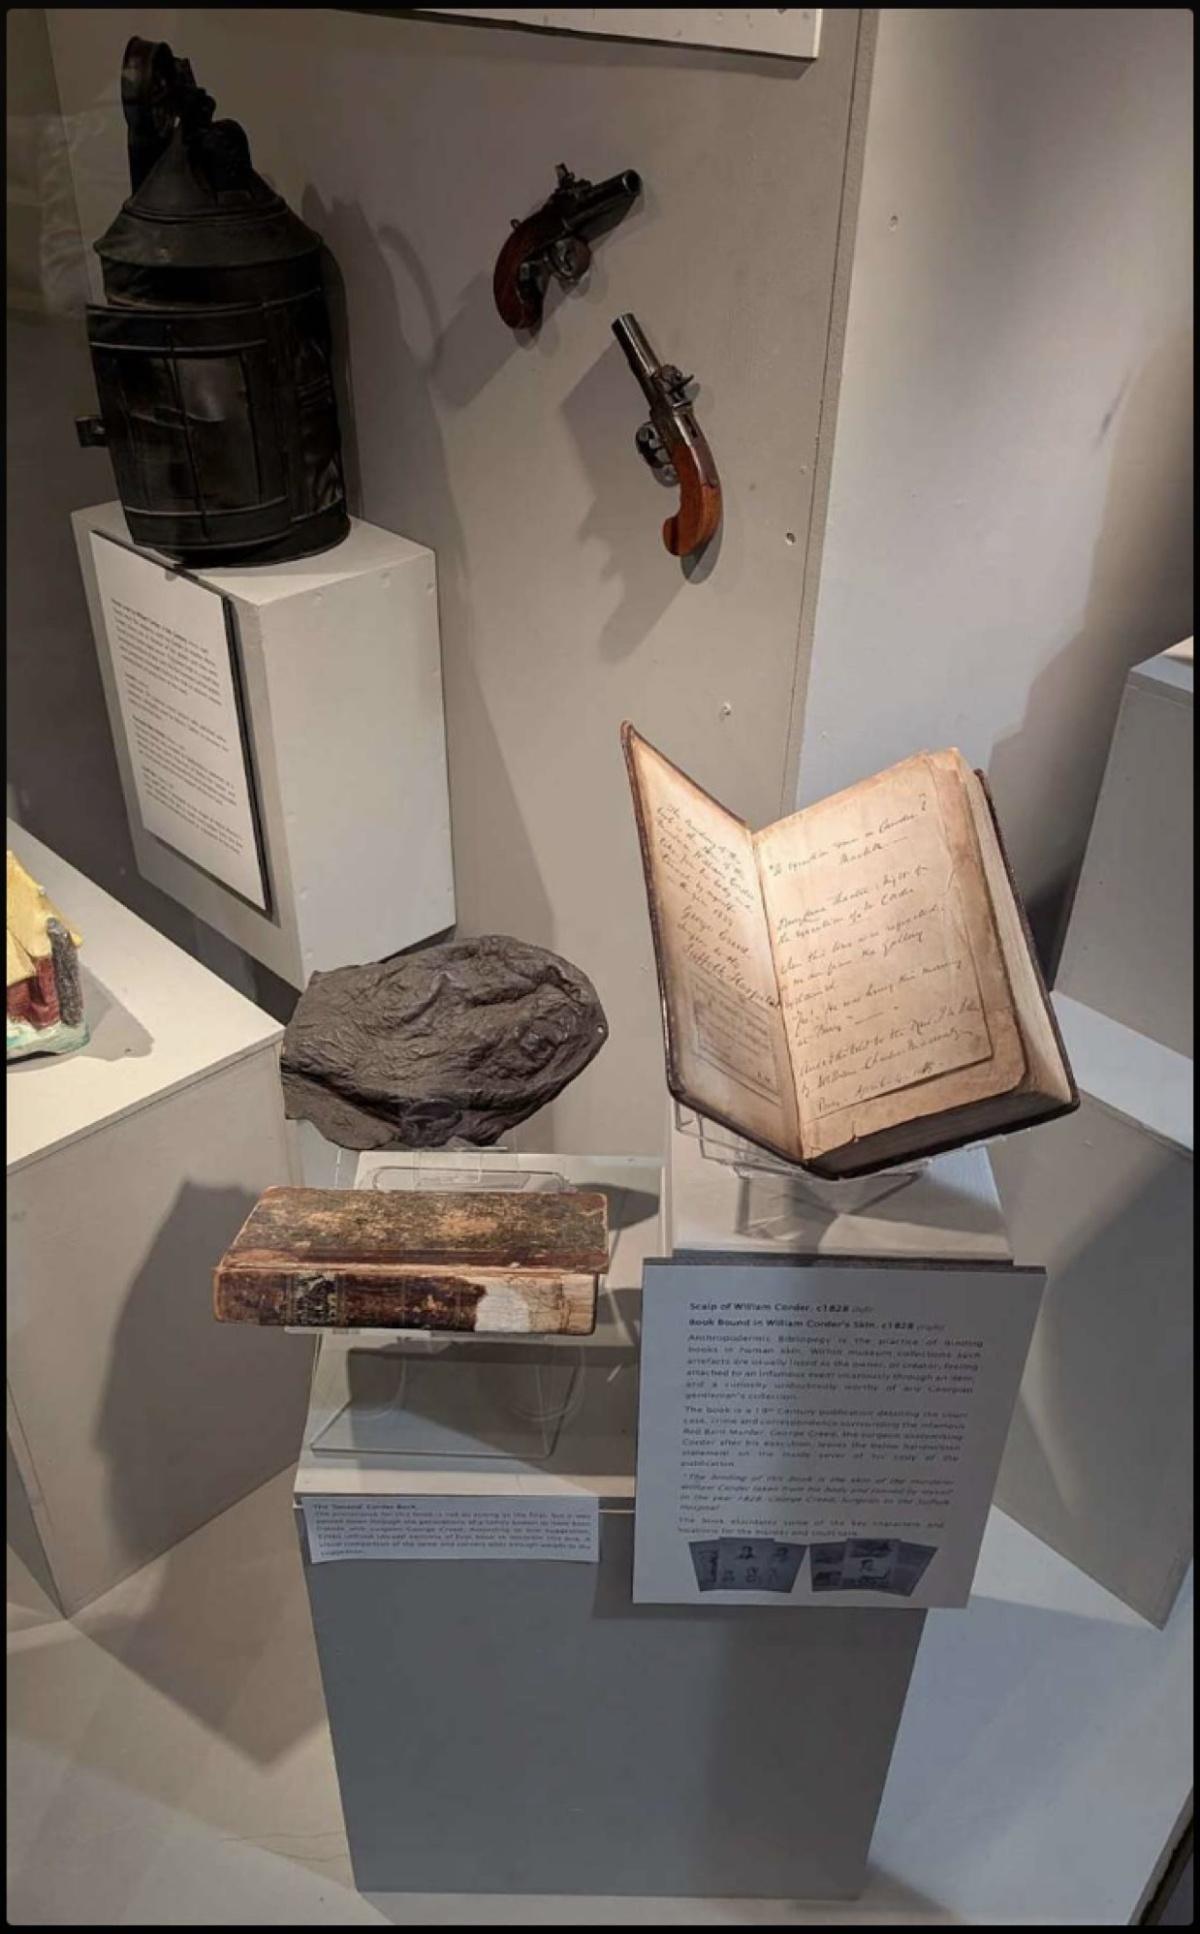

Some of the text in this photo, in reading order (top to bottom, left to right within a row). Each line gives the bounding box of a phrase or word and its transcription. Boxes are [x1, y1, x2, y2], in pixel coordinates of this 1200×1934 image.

[689, 1303, 718, 1312] Scalp
[720, 1303, 732, 1311] of
[733, 1303, 772, 1311] William
[816, 1304, 849, 1313] c1828
[688, 1318, 715, 1327] Book
[717, 1319, 751, 1327] Bound
[752, 1319, 764, 1327] in
[766, 1319, 804, 1328] William
[806, 1319, 850, 1329] Corder's
[882, 1321, 915, 1331] c1828
